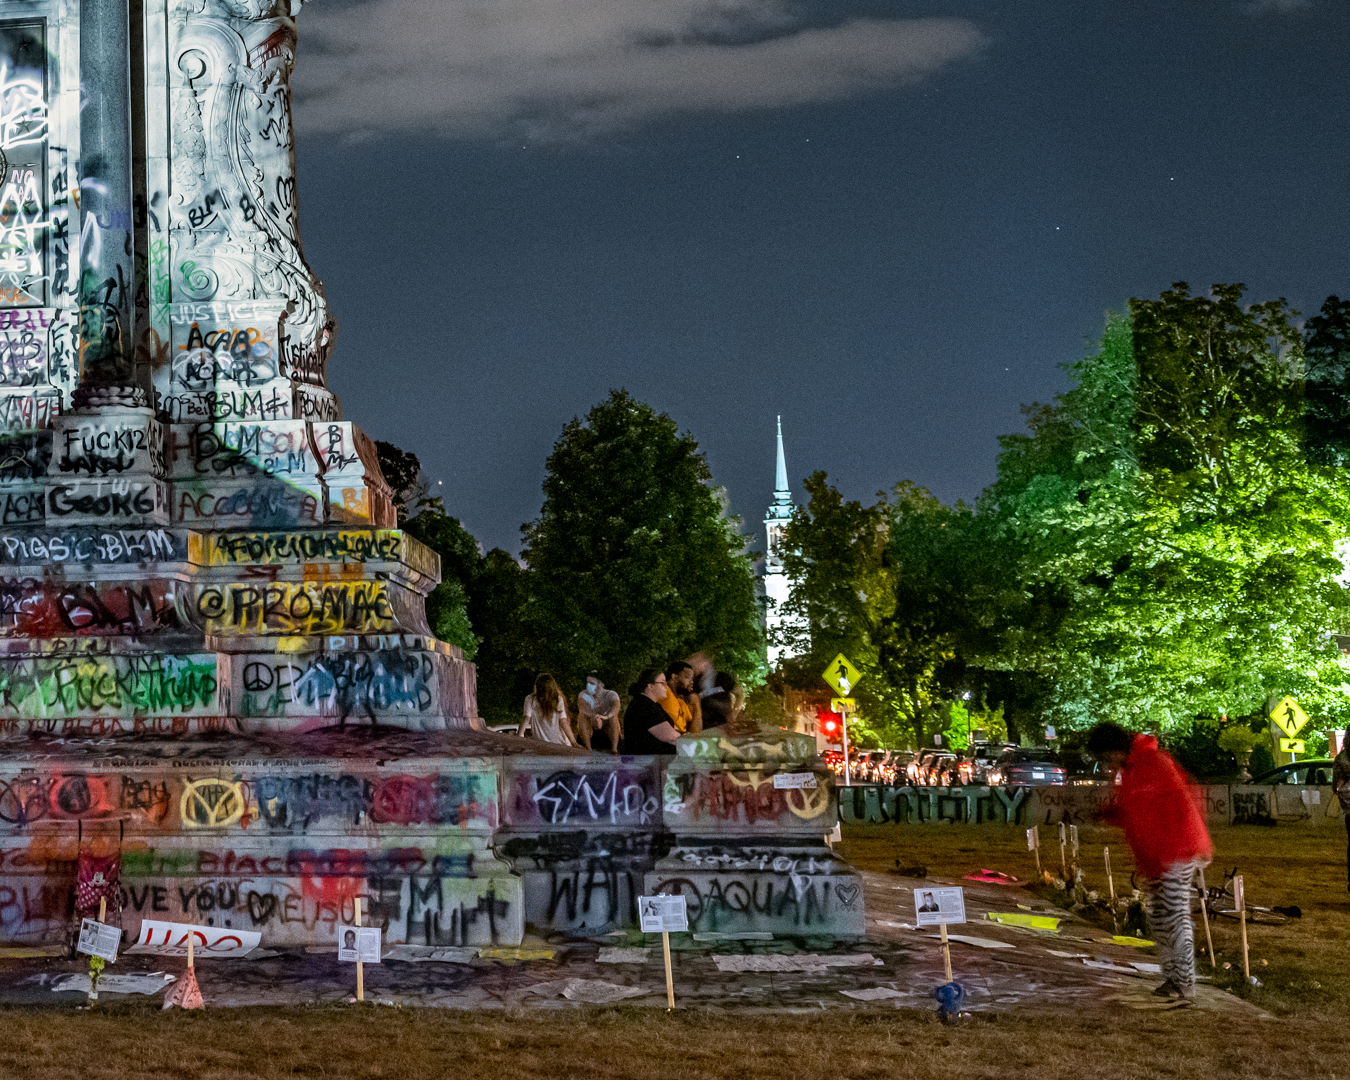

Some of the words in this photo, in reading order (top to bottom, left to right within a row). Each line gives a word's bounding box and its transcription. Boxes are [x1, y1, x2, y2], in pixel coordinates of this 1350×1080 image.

[11, 170, 35, 186] NO
[171, 303, 278, 324] JUSTICE
[118, 886, 169, 914] OVE
[178, 886, 237, 915] YOU
